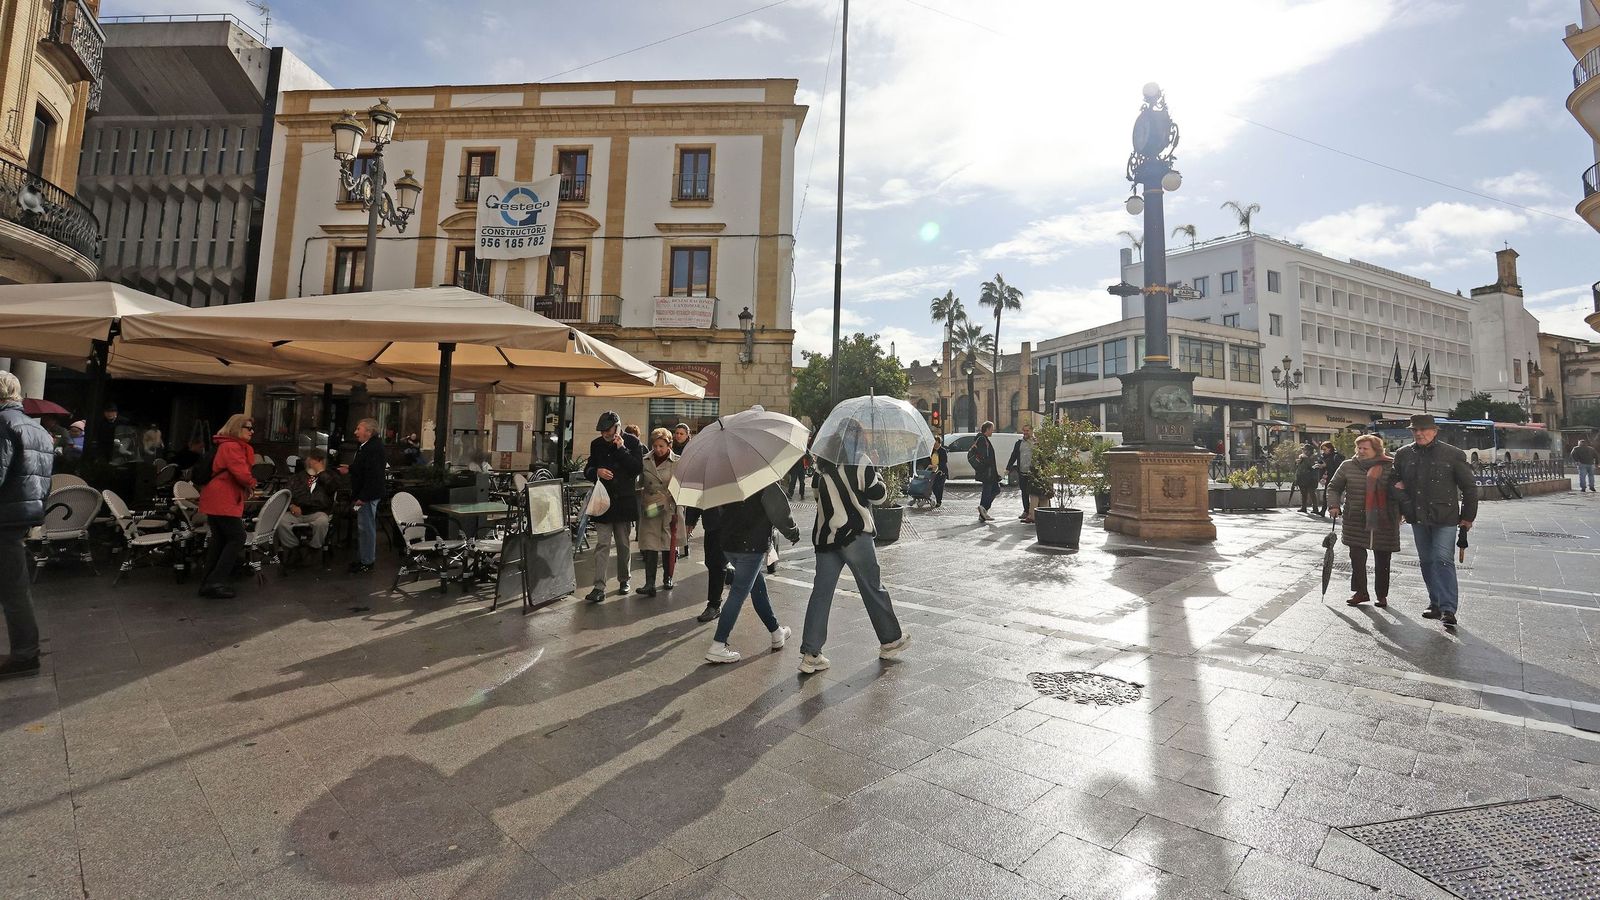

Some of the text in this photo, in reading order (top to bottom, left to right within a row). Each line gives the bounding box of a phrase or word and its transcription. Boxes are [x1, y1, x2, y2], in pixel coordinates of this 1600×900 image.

[485, 194, 550, 211] Gesteco
[481, 227, 546, 236] CONSTRUCTORA
[481, 236, 544, 248] 956 185 782
